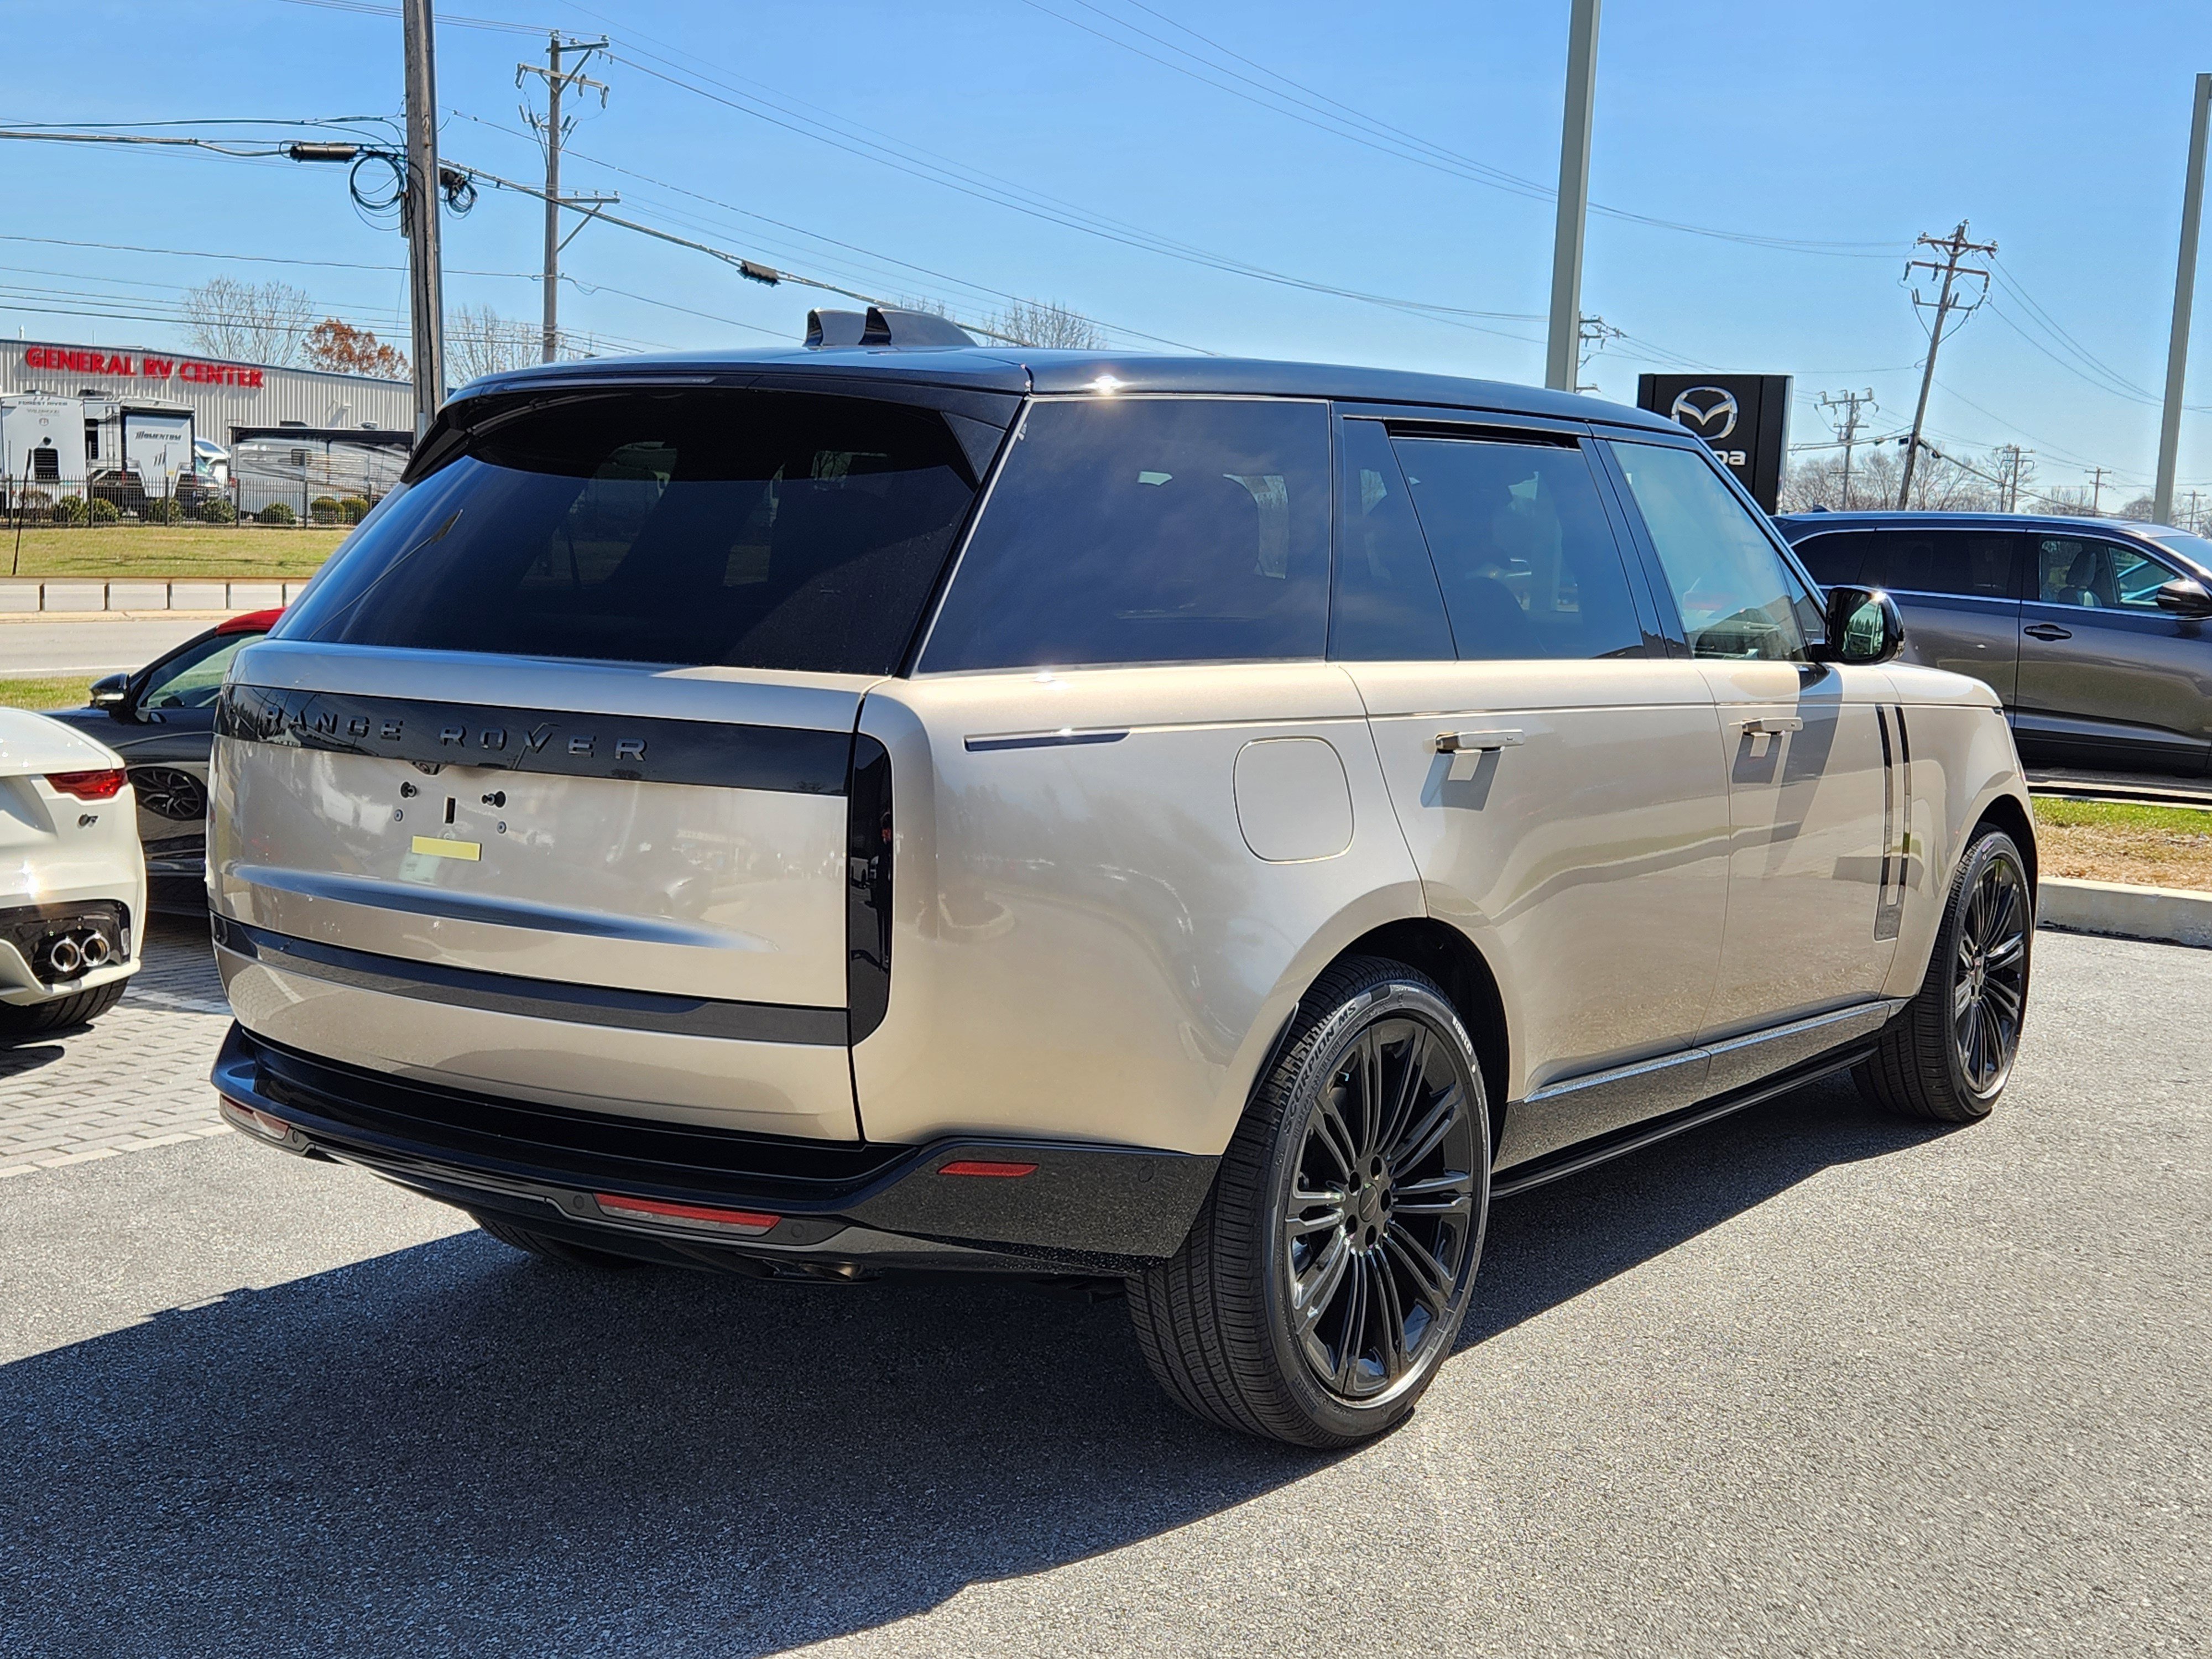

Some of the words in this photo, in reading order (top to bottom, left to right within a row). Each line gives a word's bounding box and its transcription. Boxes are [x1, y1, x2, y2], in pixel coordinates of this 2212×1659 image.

[25, 347, 137, 376] GENERAL
[144, 358, 174, 379] RV
[180, 362, 264, 389] CENTER
[265, 706, 404, 742] RANGE
[440, 724, 648, 761] ROVER
[1284, 1026, 1335, 1136] SCORPION
[1338, 1001, 1357, 1027] MS
